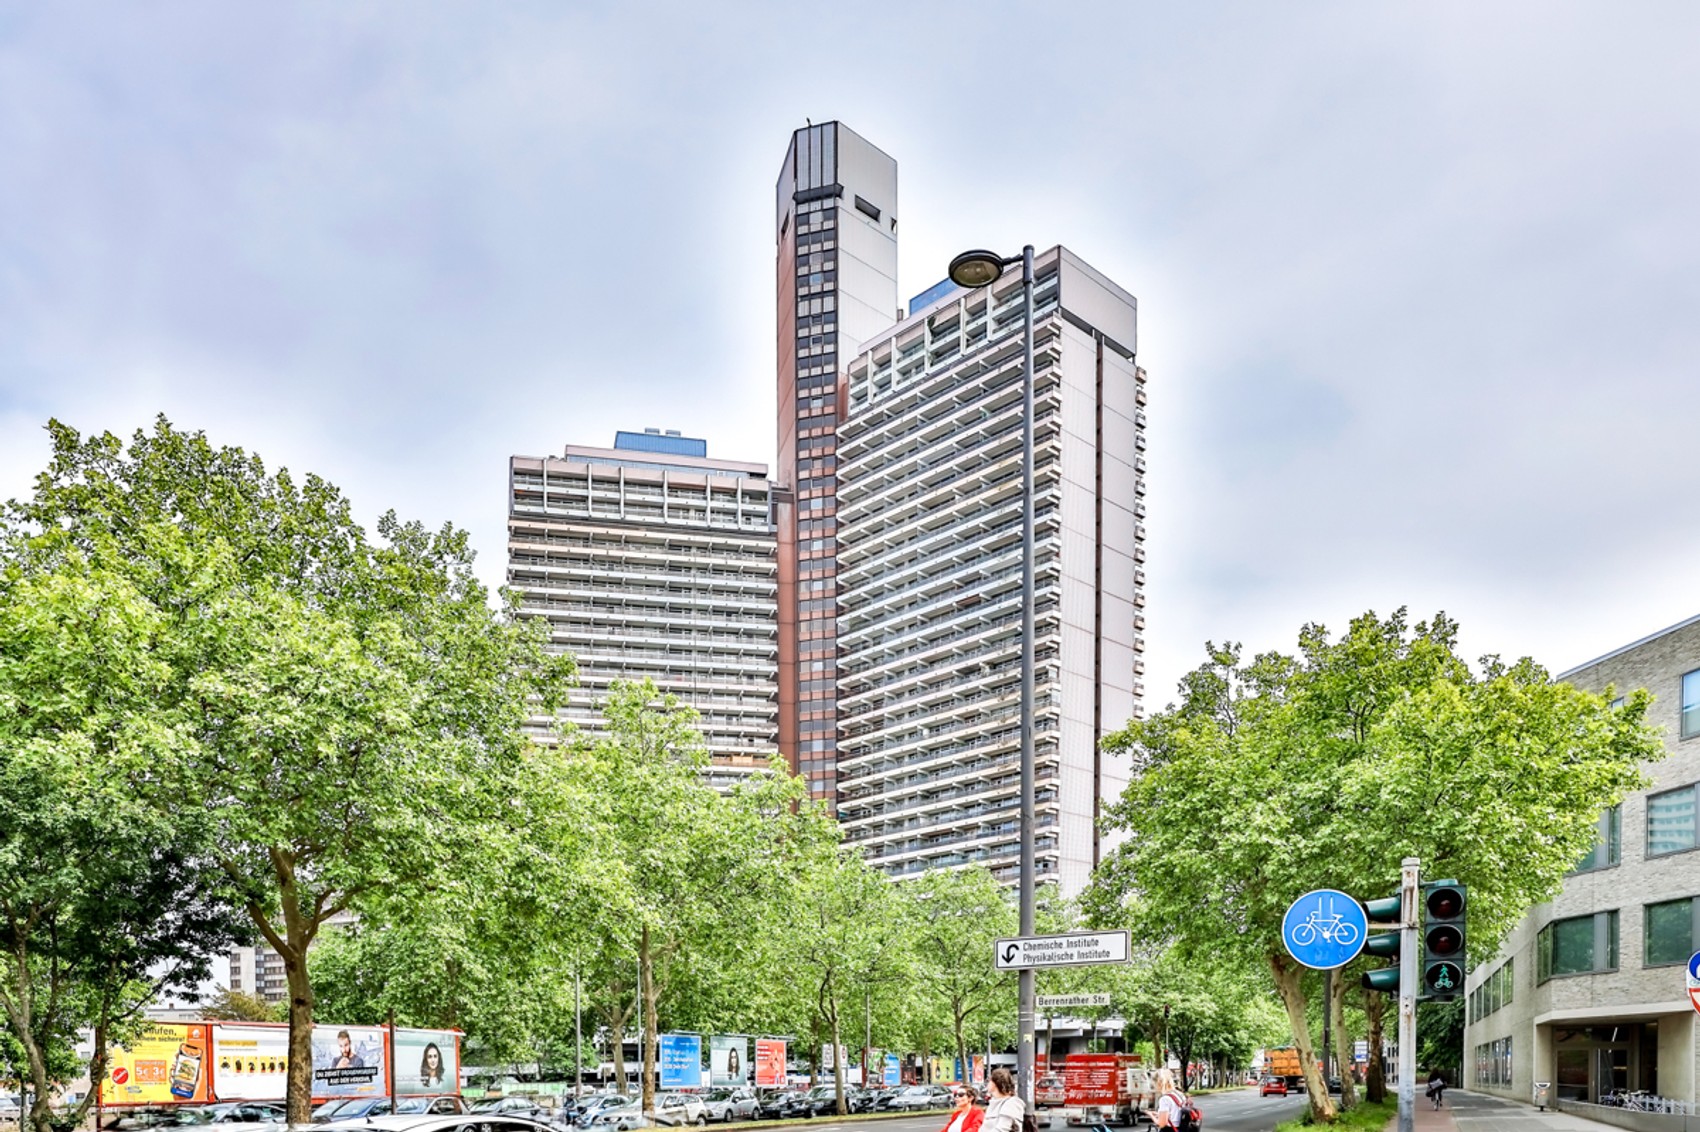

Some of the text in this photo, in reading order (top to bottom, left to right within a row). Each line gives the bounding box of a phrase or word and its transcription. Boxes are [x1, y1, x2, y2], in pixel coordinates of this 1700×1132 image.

[1023, 938, 1099, 951] Chemische Institute
[1023, 949, 1110, 963] Physikalische Institute
[1038, 994, 1107, 1006] Berrenrather Str.
